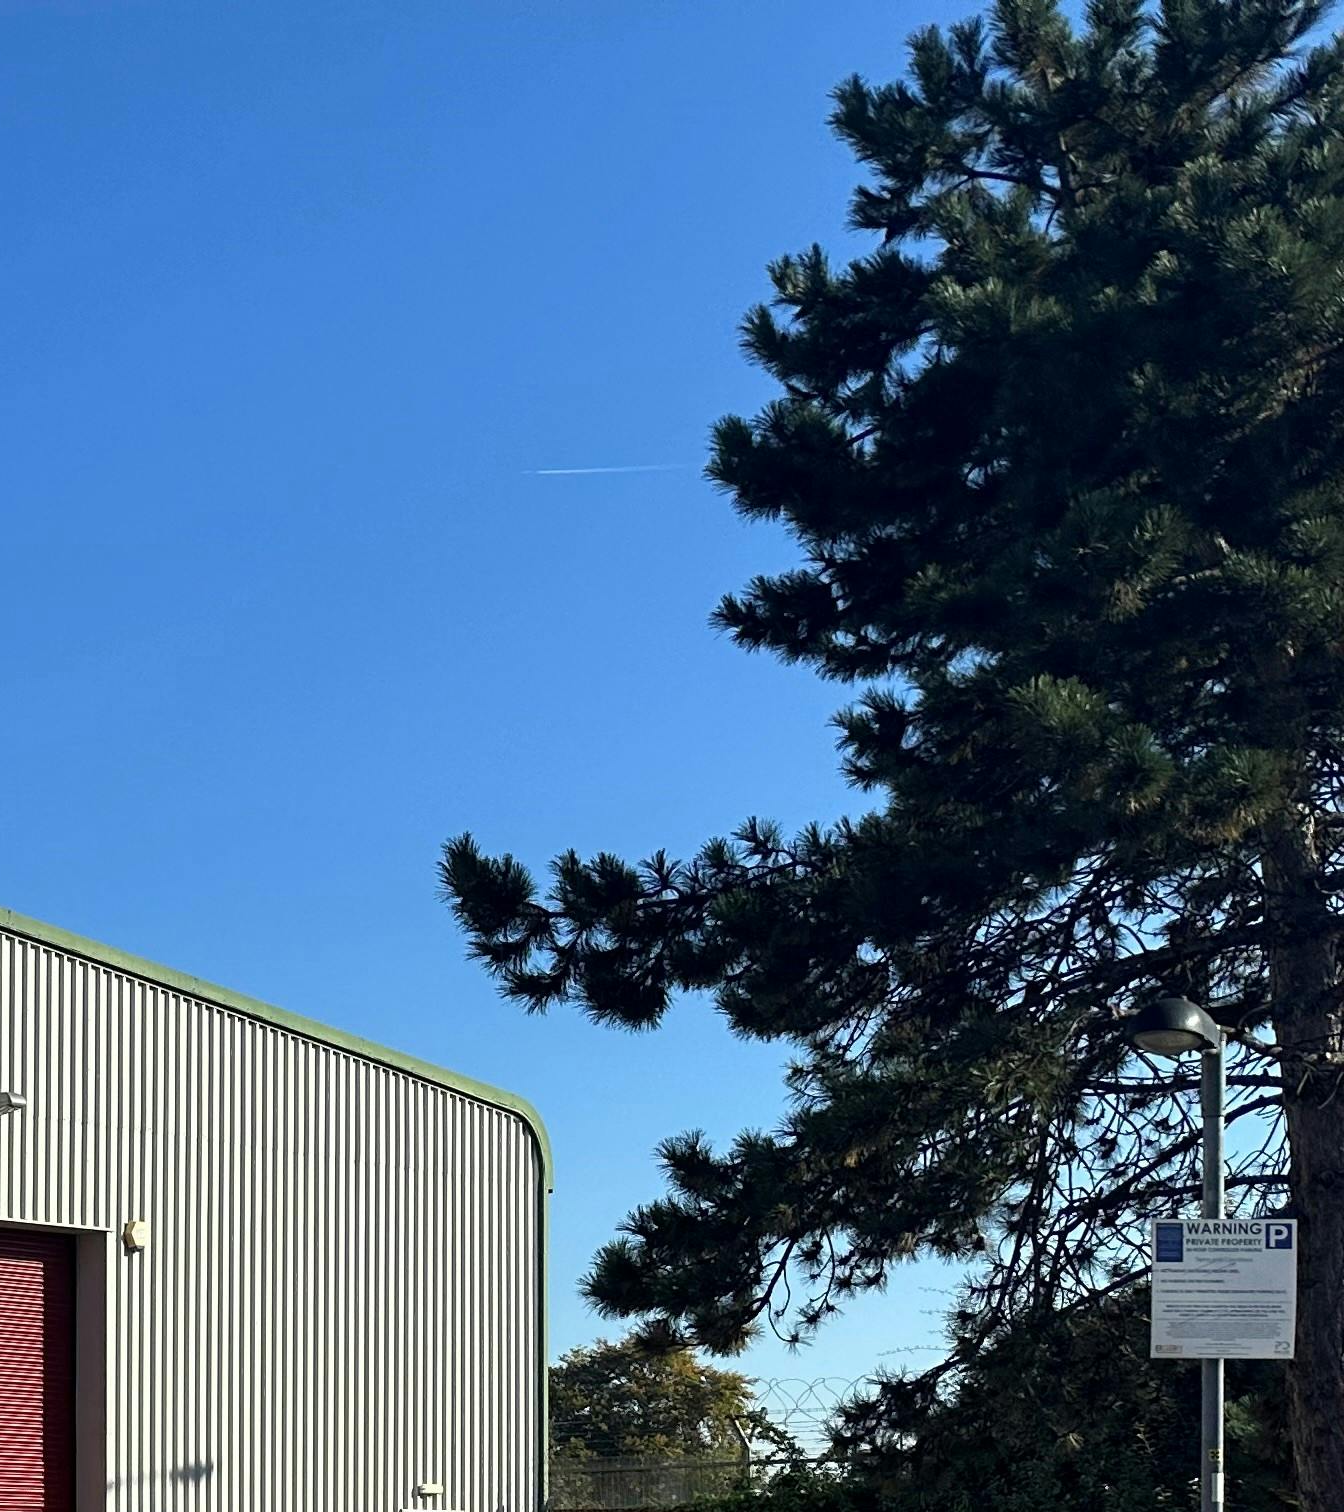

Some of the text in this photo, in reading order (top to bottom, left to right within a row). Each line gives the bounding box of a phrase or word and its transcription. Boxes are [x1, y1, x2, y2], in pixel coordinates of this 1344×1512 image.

[1186, 1223, 1262, 1235] WARNING
[1185, 1238, 1262, 1246] PRIVATE PROPERTY
[1269, 1225, 1289, 1248] P
